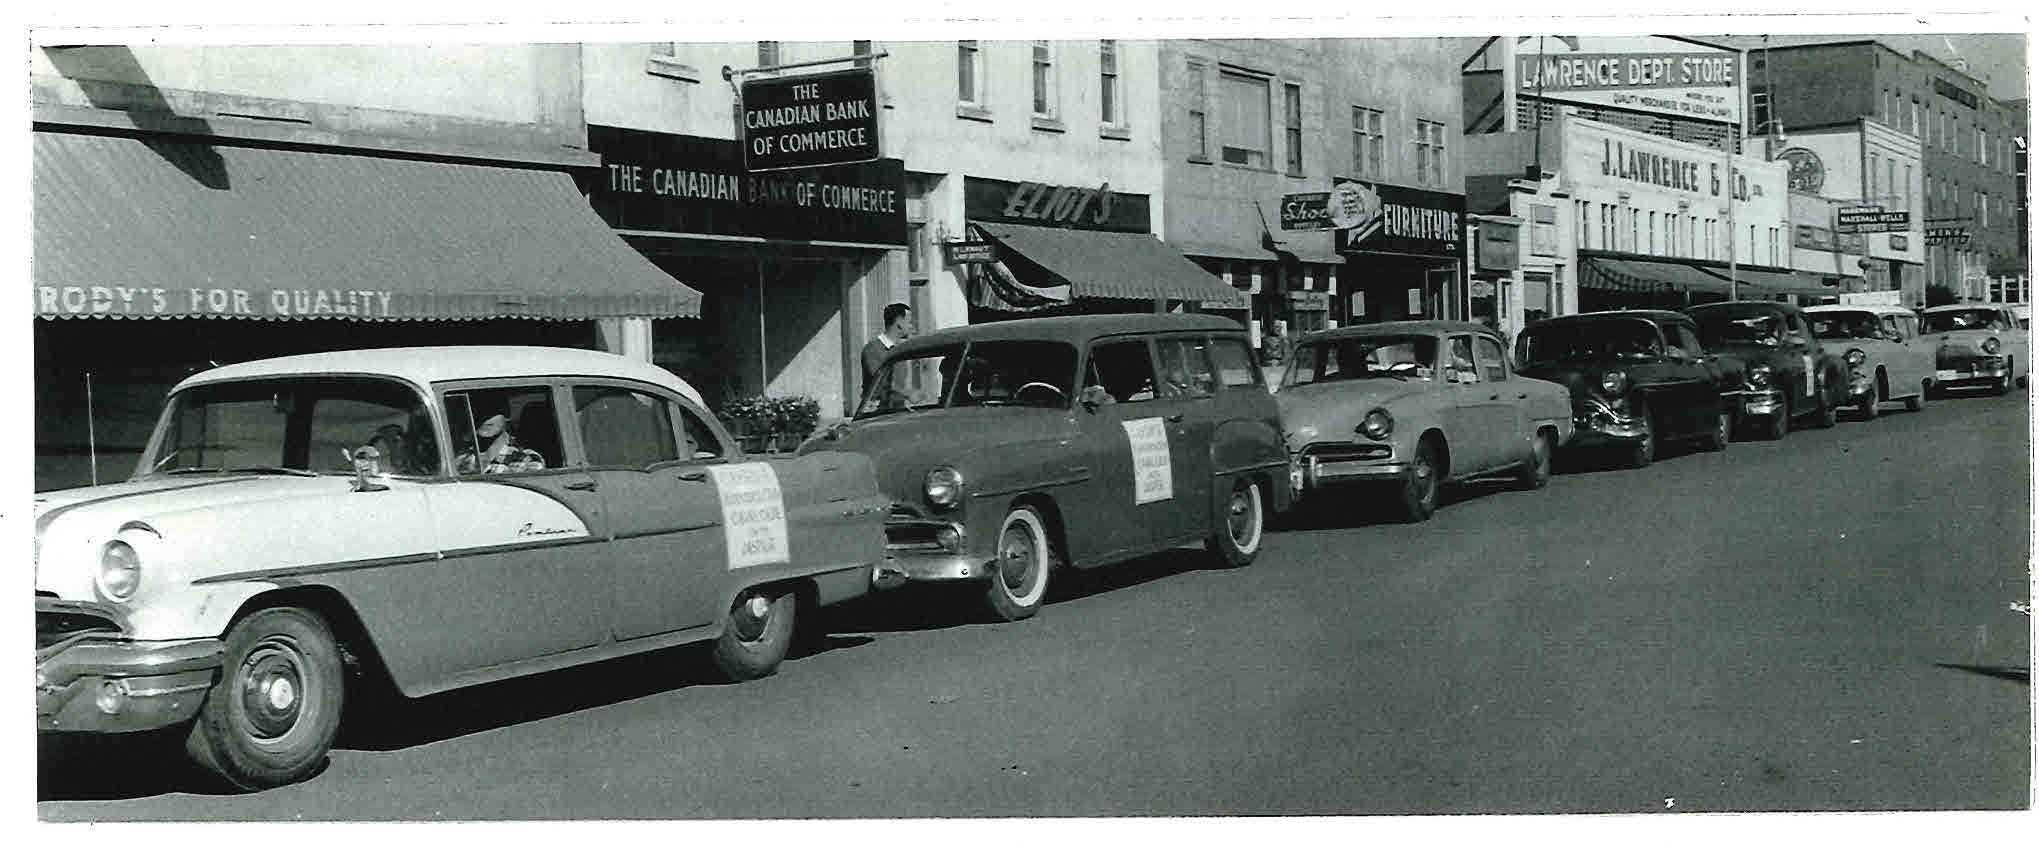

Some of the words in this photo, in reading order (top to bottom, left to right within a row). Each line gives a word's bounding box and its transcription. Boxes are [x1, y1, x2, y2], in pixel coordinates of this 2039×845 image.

[1521, 58, 1619, 89] LAWRENCE
[1681, 56, 1733, 84] STORE
[792, 83, 819, 101] THE
[746, 104, 820, 129] CANADIAN
[825, 99, 870, 121] BANK
[753, 136, 774, 155] OF
[780, 127, 867, 153] COMMERCE
[1602, 139, 1617, 176] J.
[1618, 142, 1698, 192] LAWRENCE
[608, 164, 643, 193] THE
[653, 168, 739, 201] CANADIAN
[749, 176, 788, 203] BANK
[796, 181, 817, 206] OF
[822, 184, 896, 213] COMMERCE
[1003, 180, 1113, 224] ELIOT'S
[1384, 203, 1459, 241] FURNITURE
[190, 287, 250, 314] FOR
[271, 288, 392, 316] QUALITY
